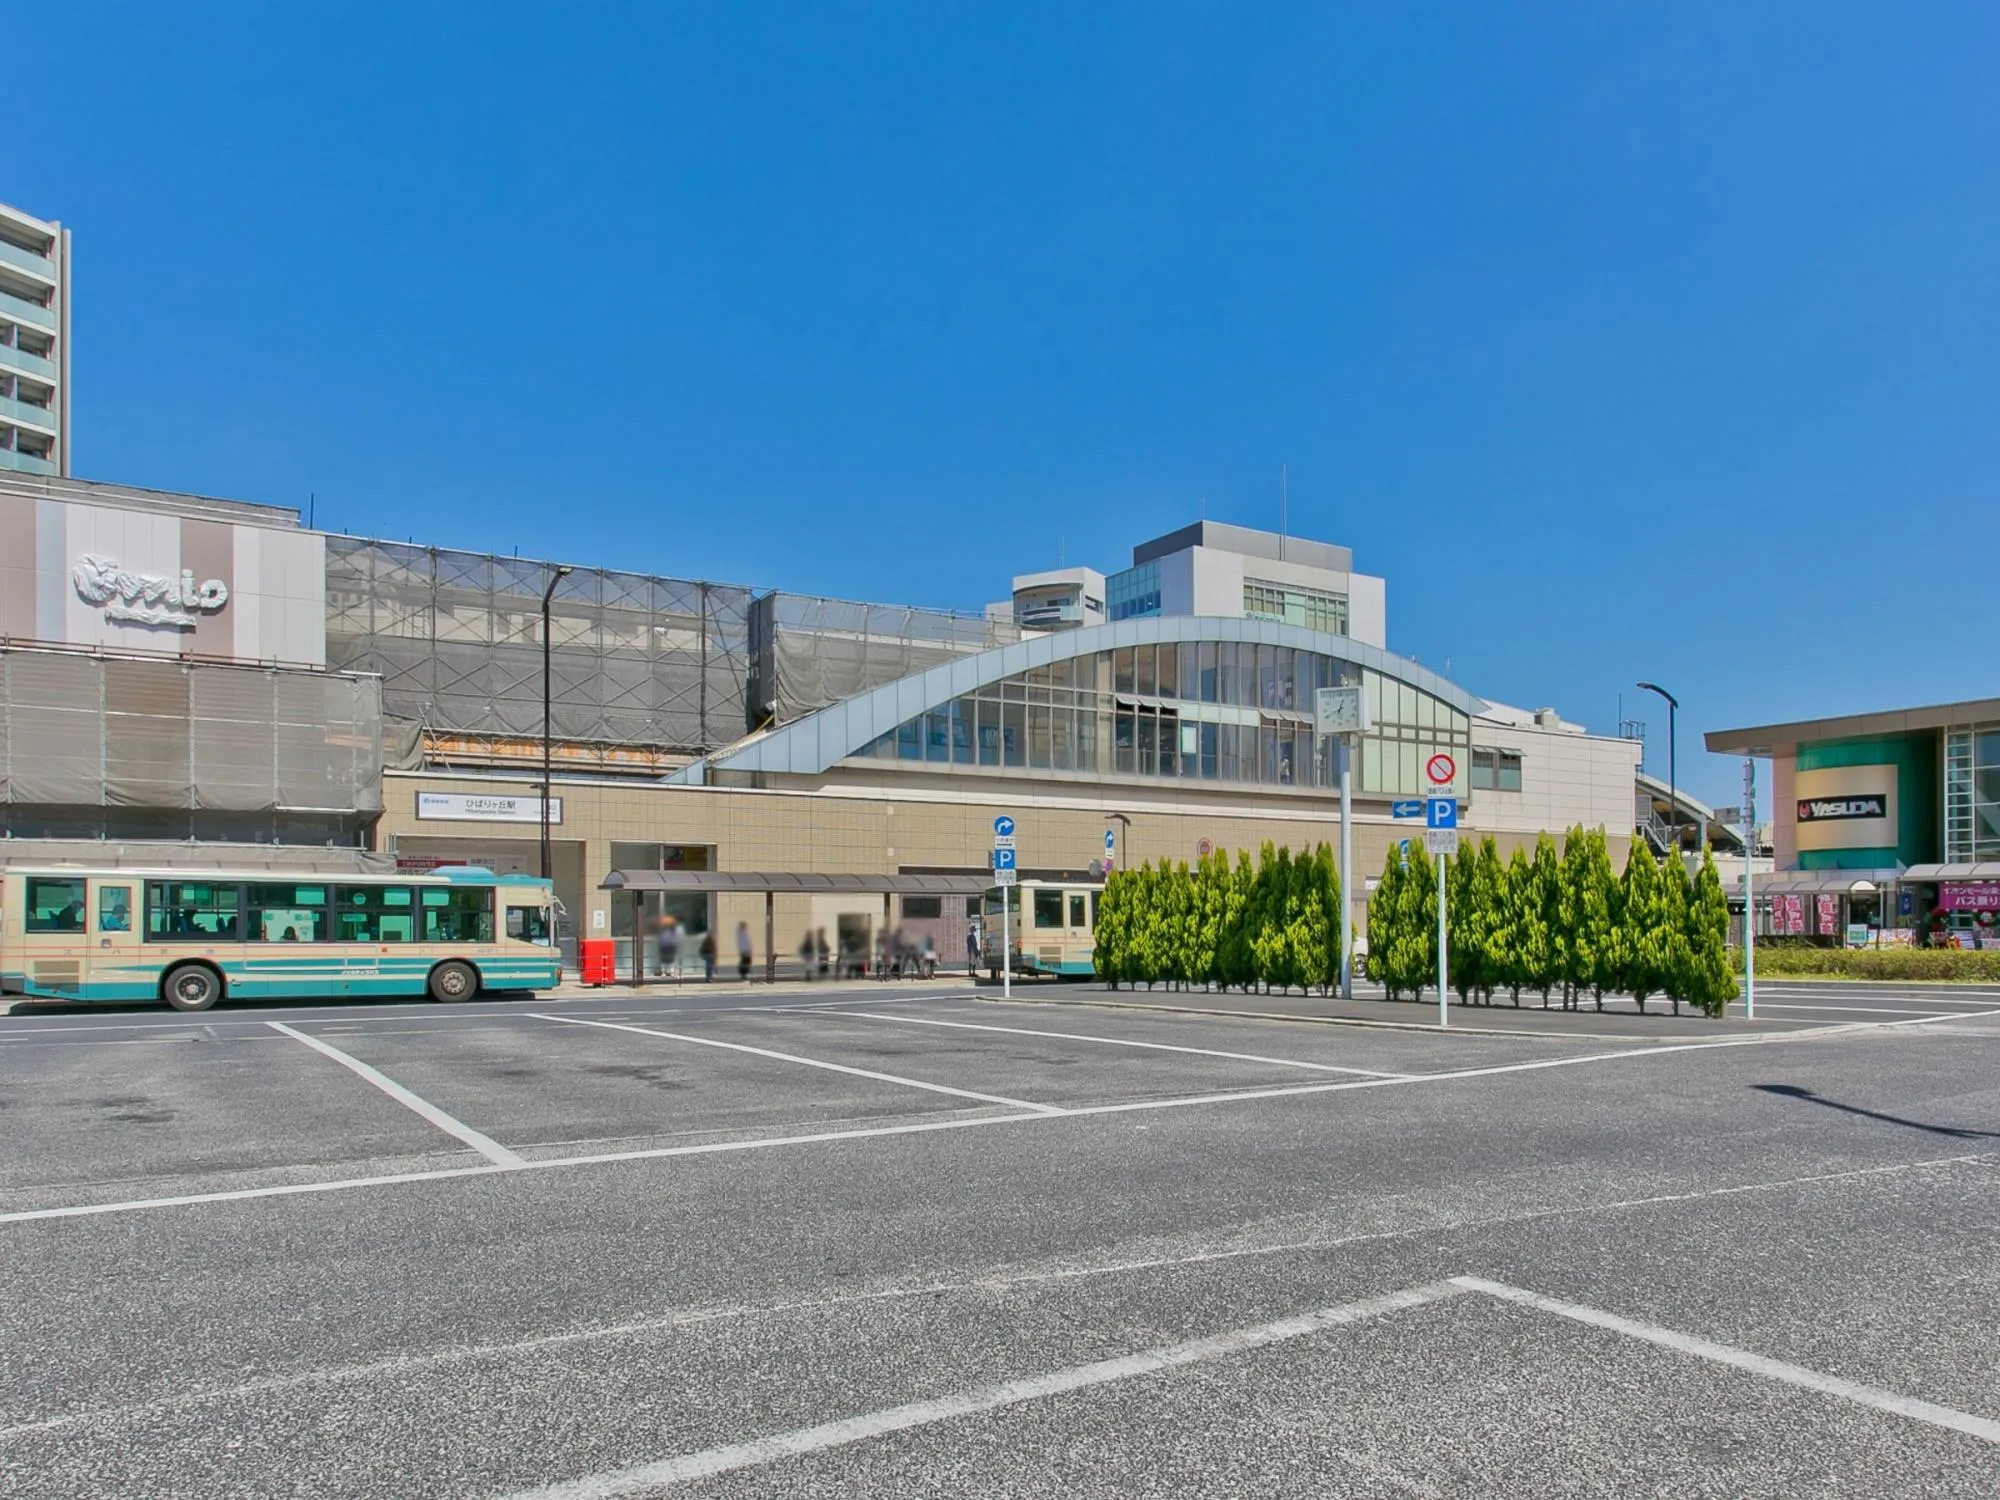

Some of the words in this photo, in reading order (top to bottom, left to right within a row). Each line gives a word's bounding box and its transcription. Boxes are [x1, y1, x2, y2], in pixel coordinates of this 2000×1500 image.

[465, 799, 516, 809] ひばりヶ丘駅
[1810, 800, 1882, 817] YASUDA
[1434, 801, 1452, 826] P
[1000, 851, 1013, 868] P
[1955, 896, 2000, 906] バス乗り
